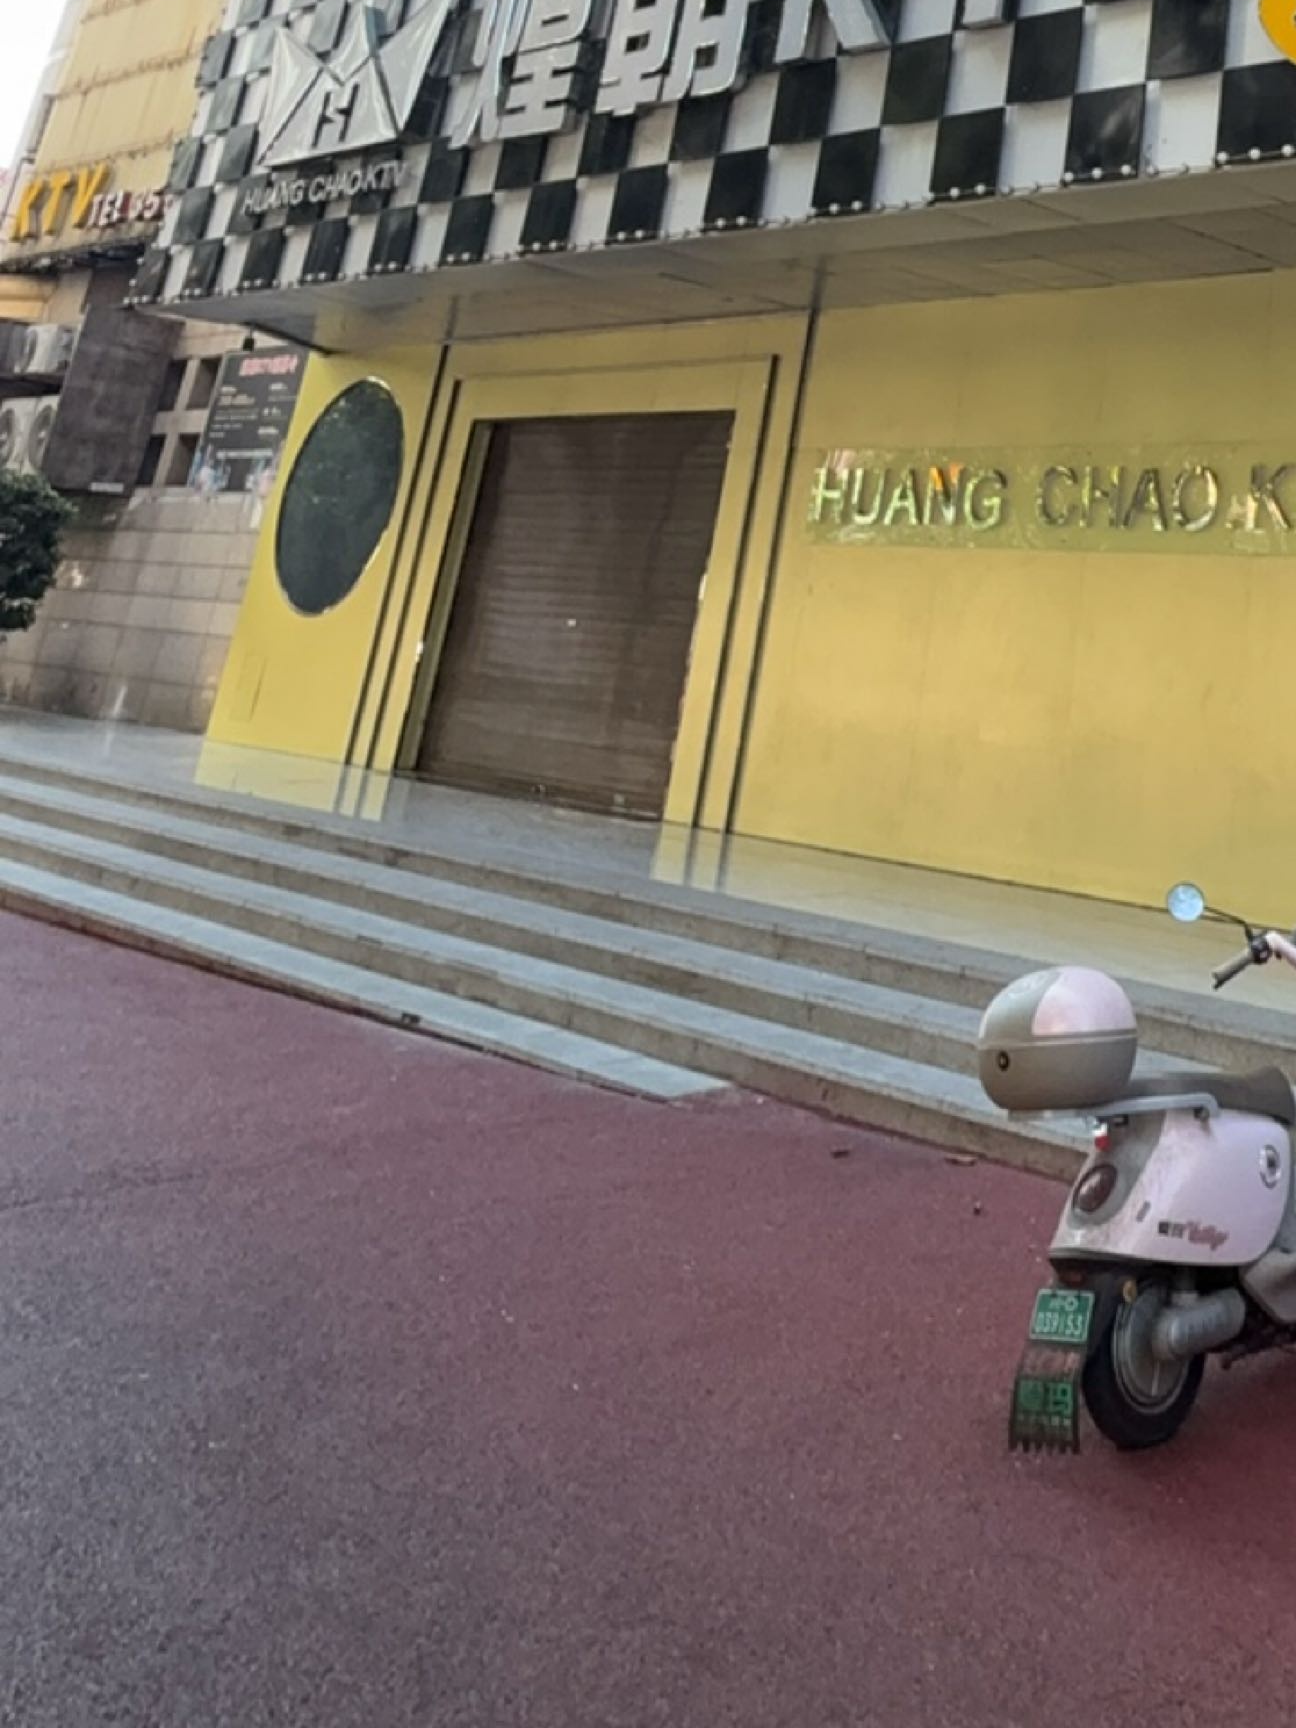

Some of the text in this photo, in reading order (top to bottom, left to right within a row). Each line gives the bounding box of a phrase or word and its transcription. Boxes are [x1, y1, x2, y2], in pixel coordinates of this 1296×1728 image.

[11, 161, 110, 240] KTV
[811, 465, 1007, 530] HUANG
[1036, 463, 1219, 534] CHAO
